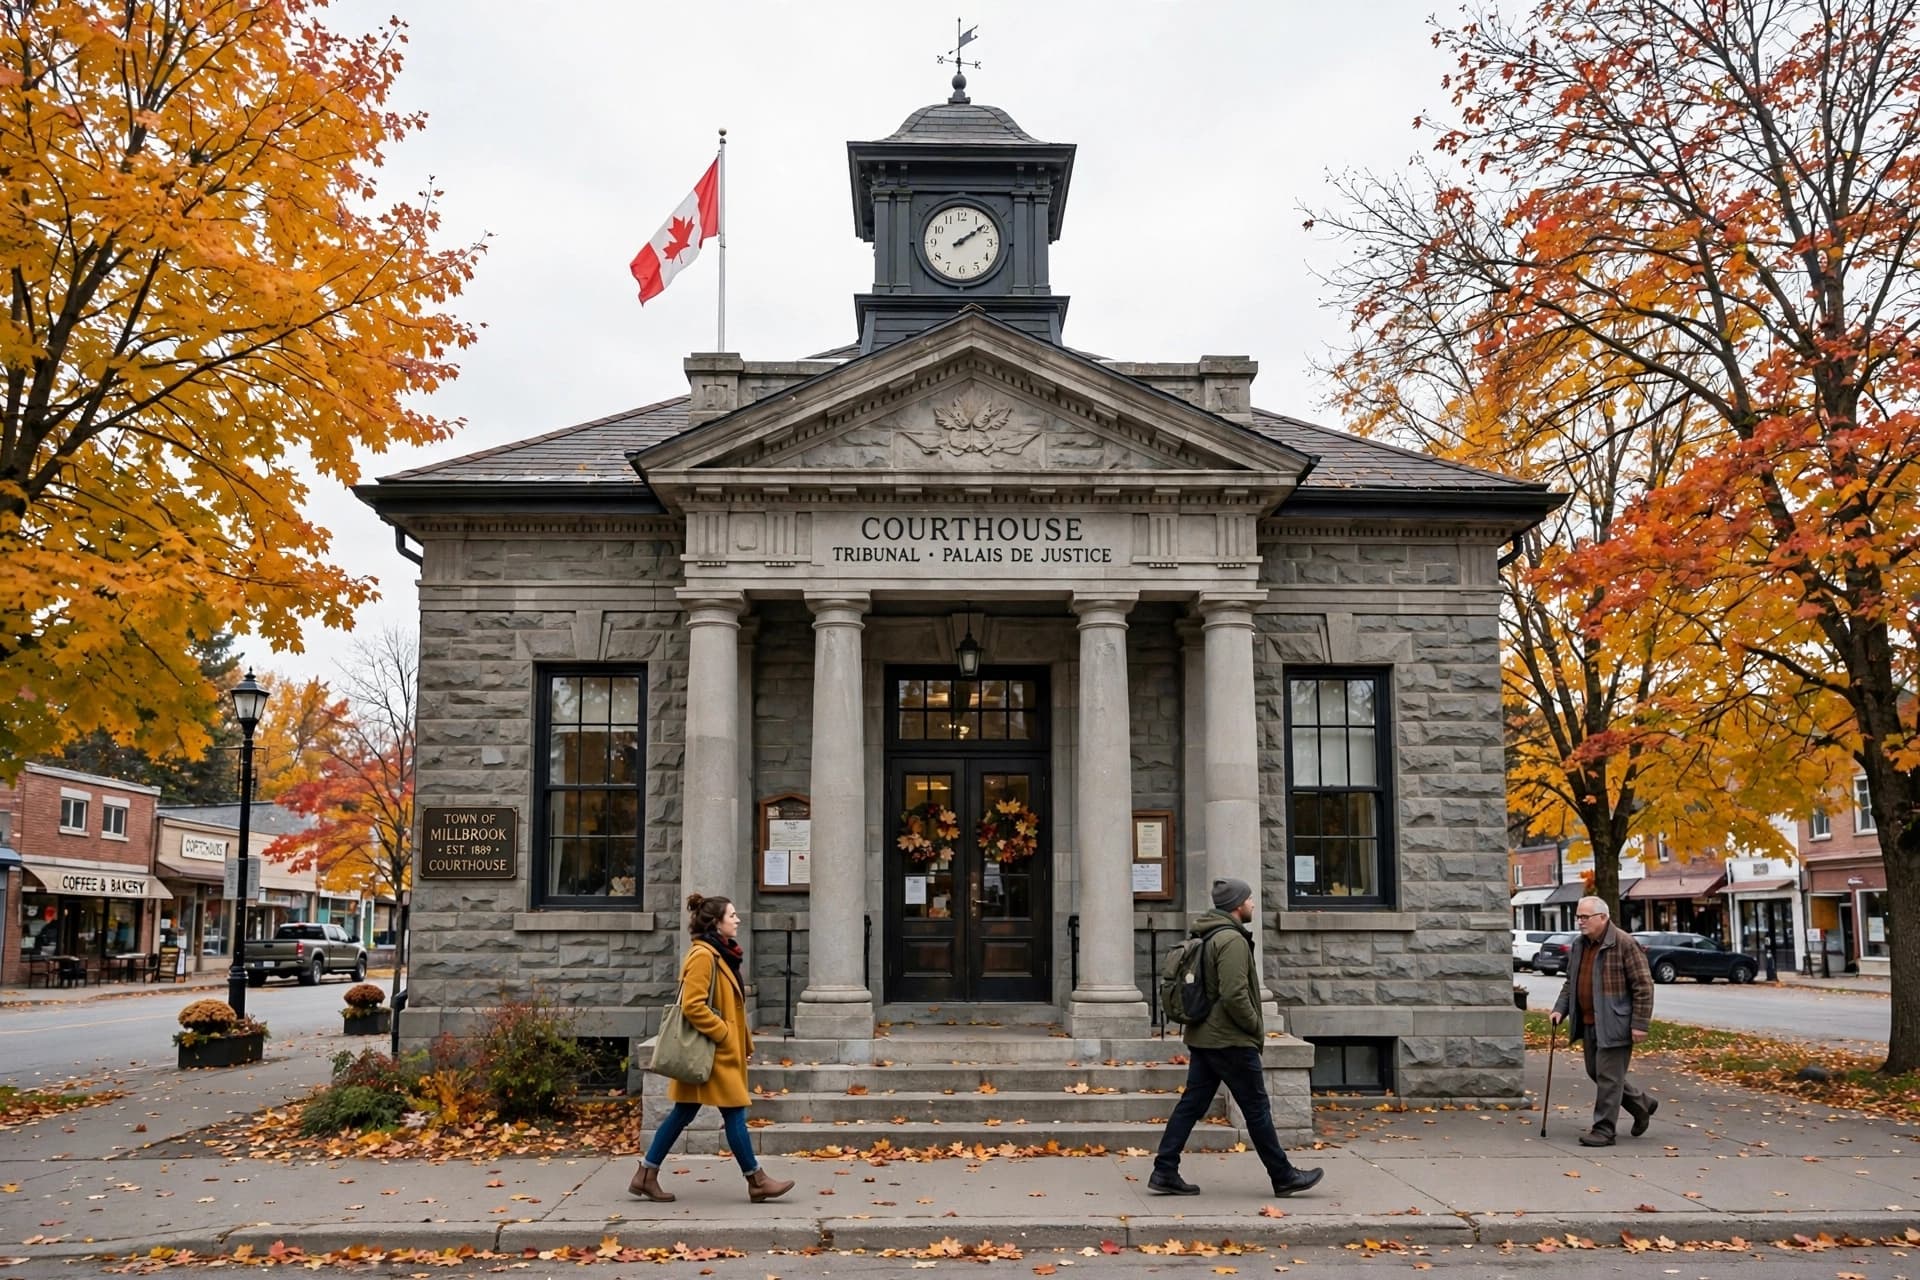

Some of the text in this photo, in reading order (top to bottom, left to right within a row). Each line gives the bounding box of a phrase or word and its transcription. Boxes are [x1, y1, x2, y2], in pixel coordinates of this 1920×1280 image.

[945, 215, 952, 225] 11
[957, 211, 967, 222] 12
[934, 225, 944, 234] 10
[982, 224, 990, 234] 2
[930, 238, 937, 248] 9
[987, 238, 993, 248] 3
[934, 252, 942, 261] 8
[945, 261, 951, 271] 7
[958, 266, 965, 275] 6
[861, 516, 1083, 542] COURTHOUSE
[832, 546, 1112, 563] TRIBUNAL PALAIS DE JUSTICE
[444, 813, 496, 824] TOWN OF
[430, 828, 507, 841] MILLBROOK
[446, 844, 492, 855] EST. 1889
[428, 859, 508, 871] COURTHOUSE
[62, 875, 98, 891] COFFEE
